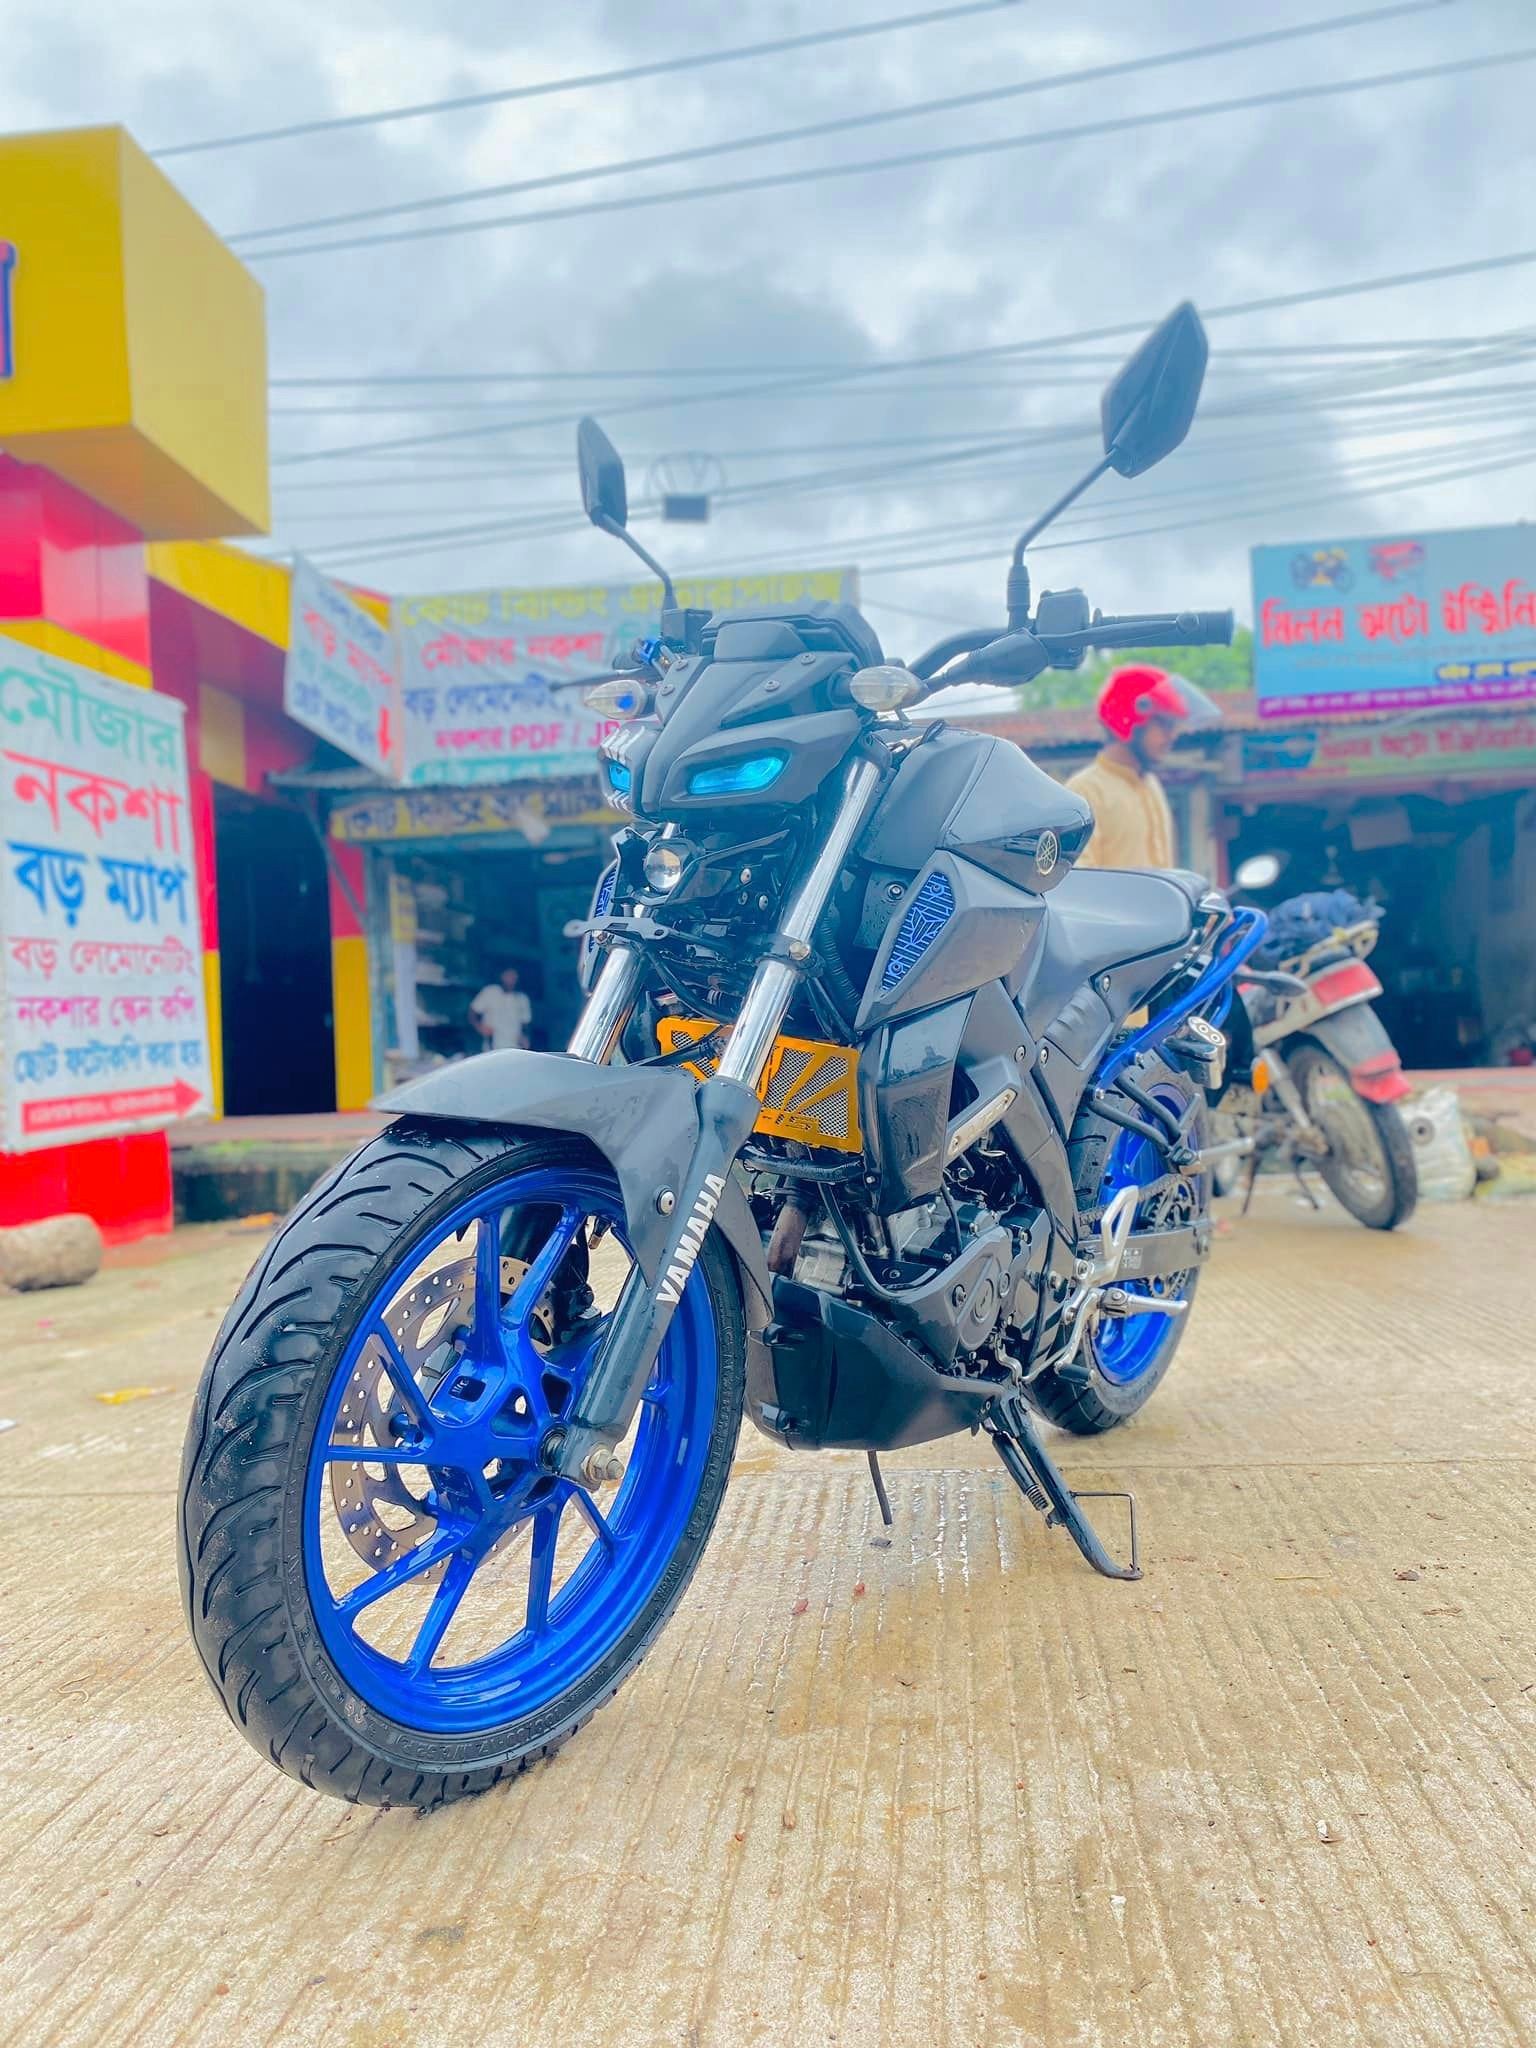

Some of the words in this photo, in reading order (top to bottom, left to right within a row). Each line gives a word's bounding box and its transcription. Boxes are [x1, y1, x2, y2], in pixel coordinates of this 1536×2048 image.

[0, 656, 178, 773] মৌজার
[511, 721, 563, 751] PDF
[5, 748, 182, 856] নকশা
[6, 839, 88, 928] বড়
[97, 856, 188, 925] ম্যাপ
[8, 936, 58, 981] বড়
[656, 1173, 726, 1303] YAMAHA
